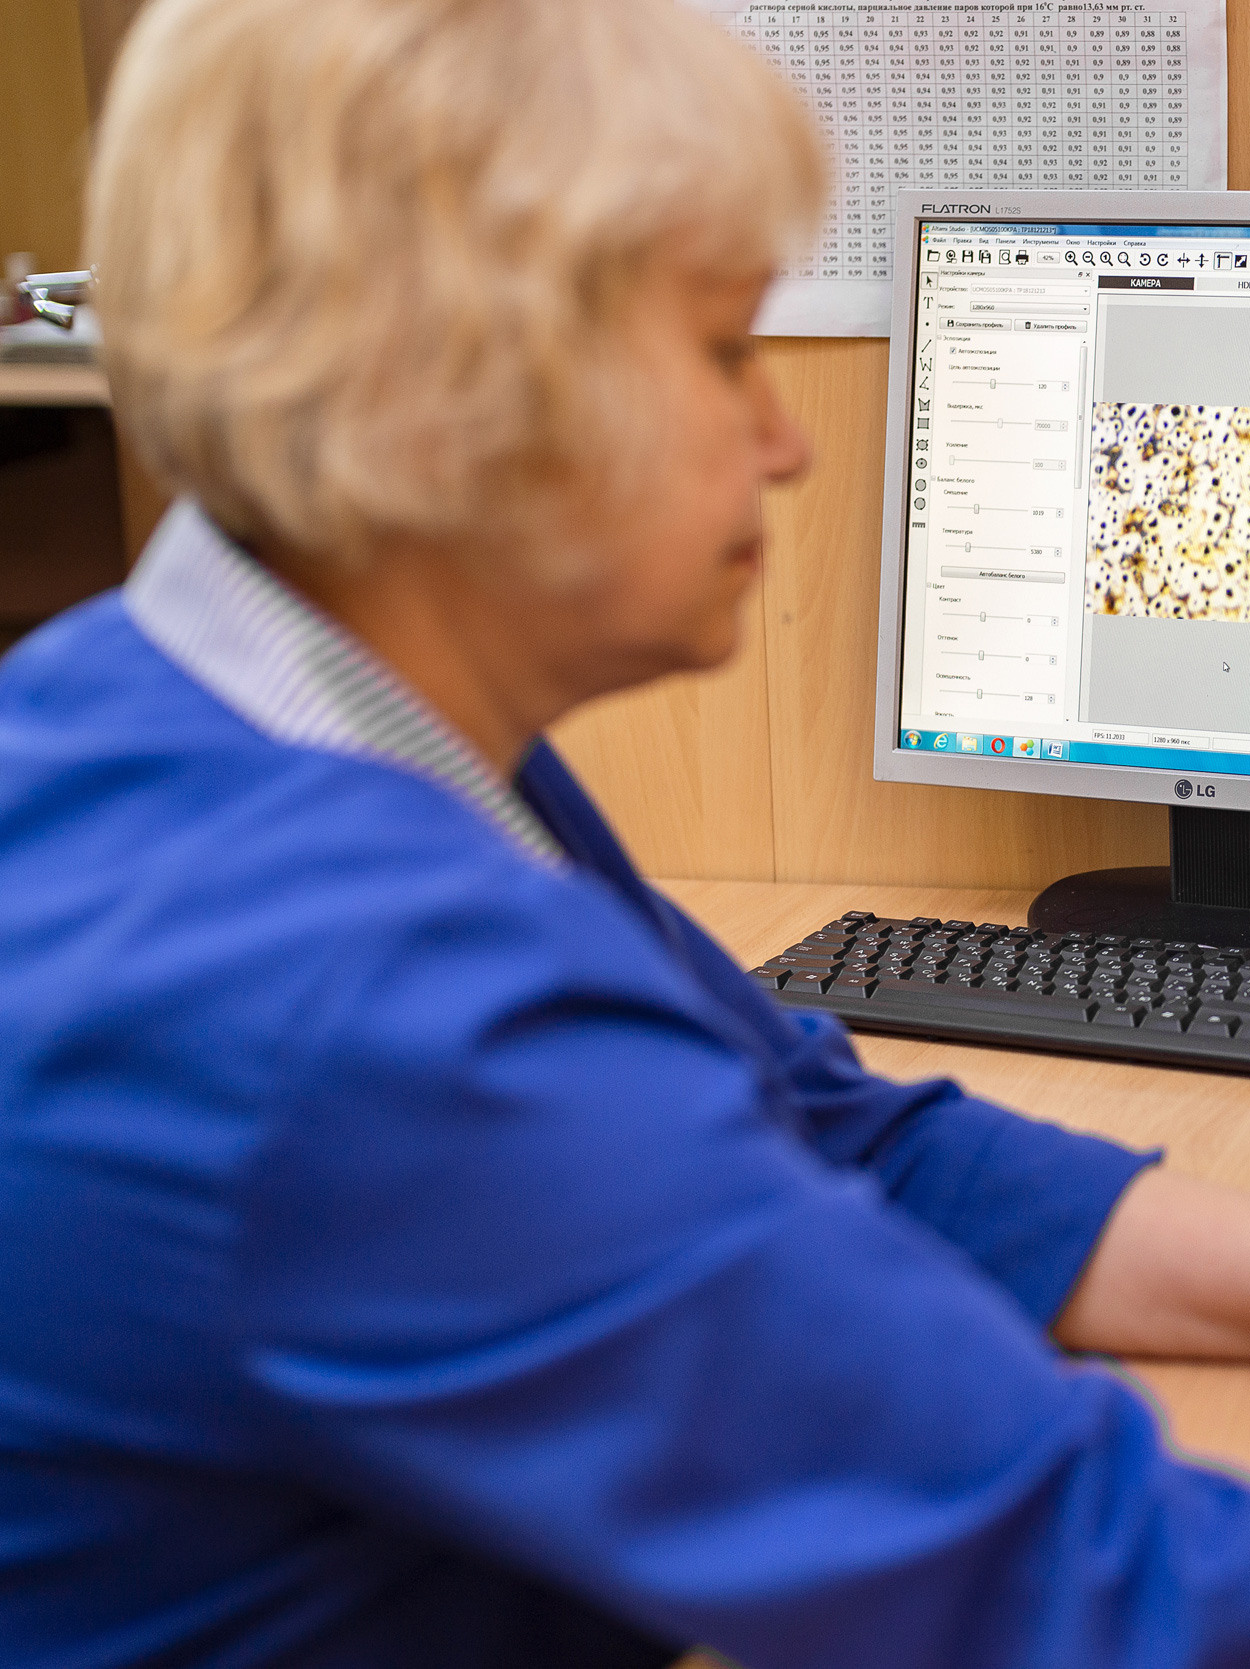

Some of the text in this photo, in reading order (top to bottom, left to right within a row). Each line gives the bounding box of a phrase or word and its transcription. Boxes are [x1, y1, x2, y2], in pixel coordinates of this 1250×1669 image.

[981, 4, 1014, 12] которой
[765, 30, 1180, 38] 0,95 0,95 0,95 0,94 0,94 0,93 0,93 0,92 0,92 0,92 0,91 0,91 0,9 0,89 0,89 0,88 0,88
[922, 204, 991, 214] FLATRON
[1130, 279, 1161, 288] КАМЕРА
[1197, 785, 1215, 797] LG
